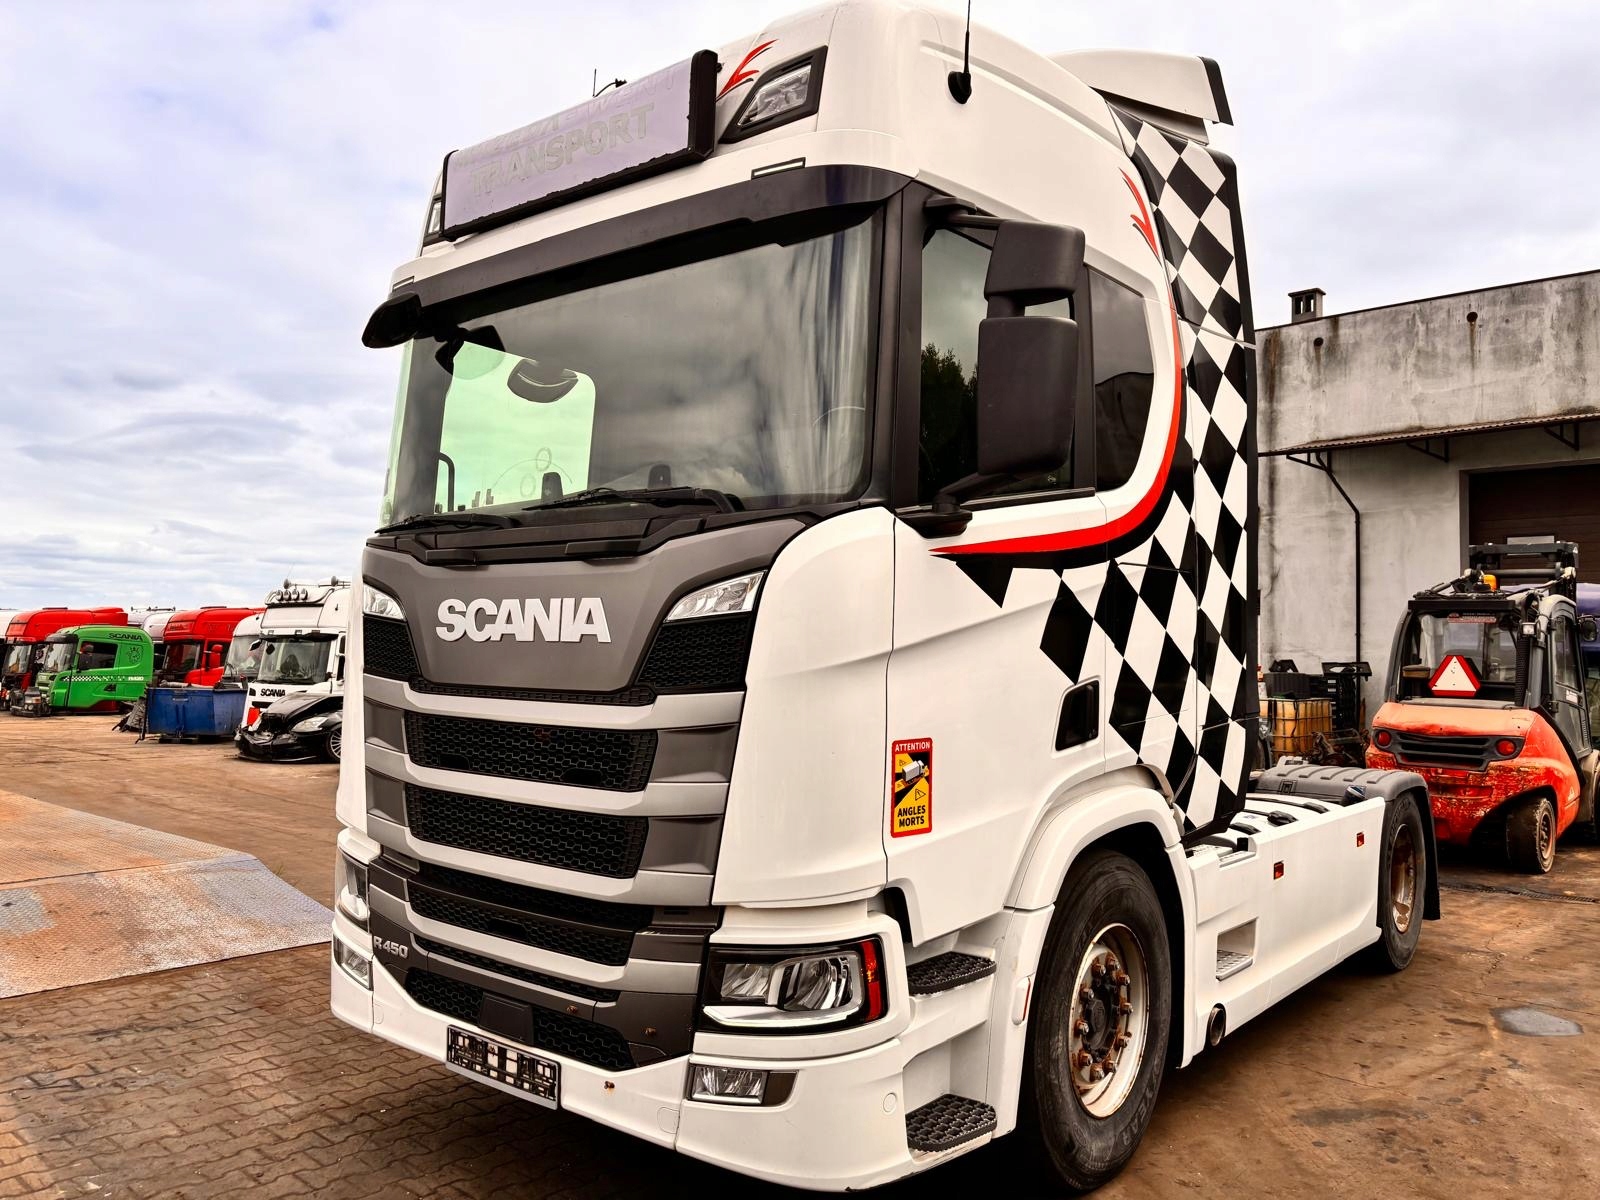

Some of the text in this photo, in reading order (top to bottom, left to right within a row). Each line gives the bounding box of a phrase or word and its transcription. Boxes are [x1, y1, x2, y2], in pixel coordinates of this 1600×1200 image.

[470, 103, 655, 195] TRANSPORT
[435, 597, 612, 643] SCANIA
[108, 632, 144, 642] SCANIA
[260, 688, 286, 697] SCANIA
[895, 741, 930, 752] ATTENTION
[897, 804, 926, 817] ANGLES
[898, 815, 925, 828] MORTS
